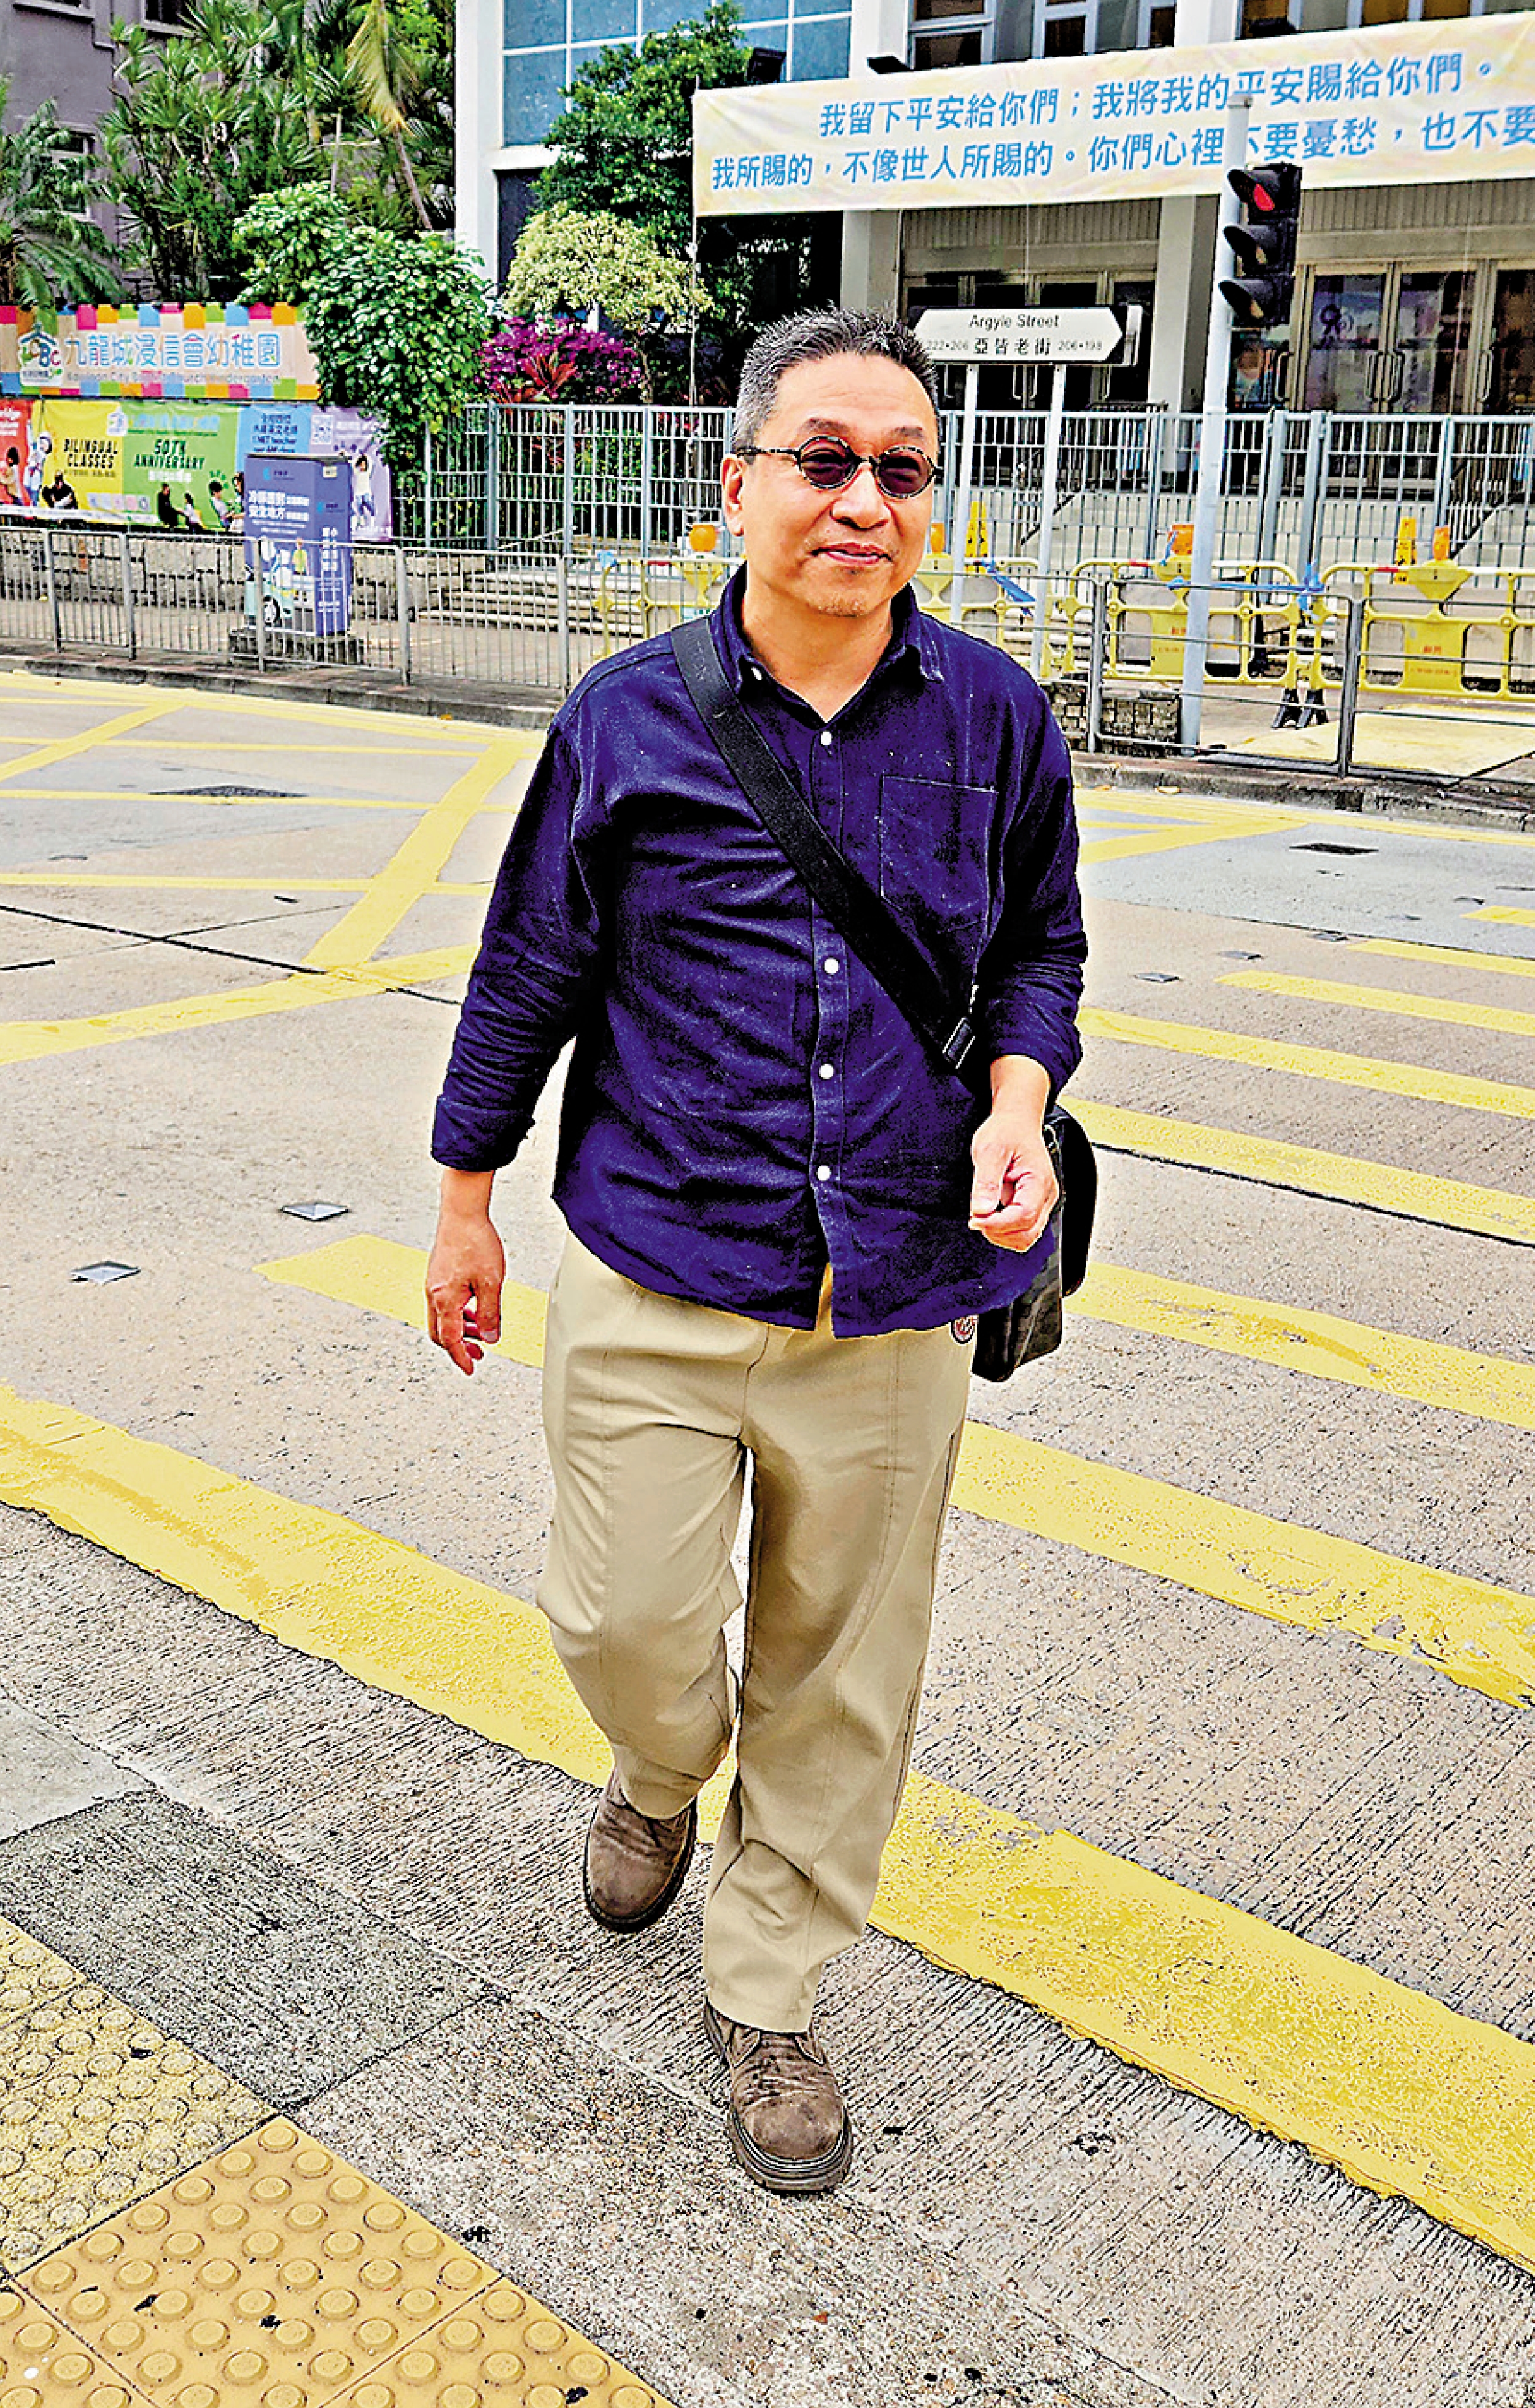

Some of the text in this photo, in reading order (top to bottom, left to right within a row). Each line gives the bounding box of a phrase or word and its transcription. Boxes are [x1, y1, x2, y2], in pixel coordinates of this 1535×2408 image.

[969, 314, 1060, 331] Argyle Street
[66, 333, 281, 368] 九龍城浸信會幼稚園
[973, 338, 1051, 356] 亞皆老街
[64, 438, 118, 455] BILINGUAL
[154, 438, 187, 455] 50TH
[67, 453, 114, 469] CLASSES
[134, 454, 206, 469] ANNIVERSARY
